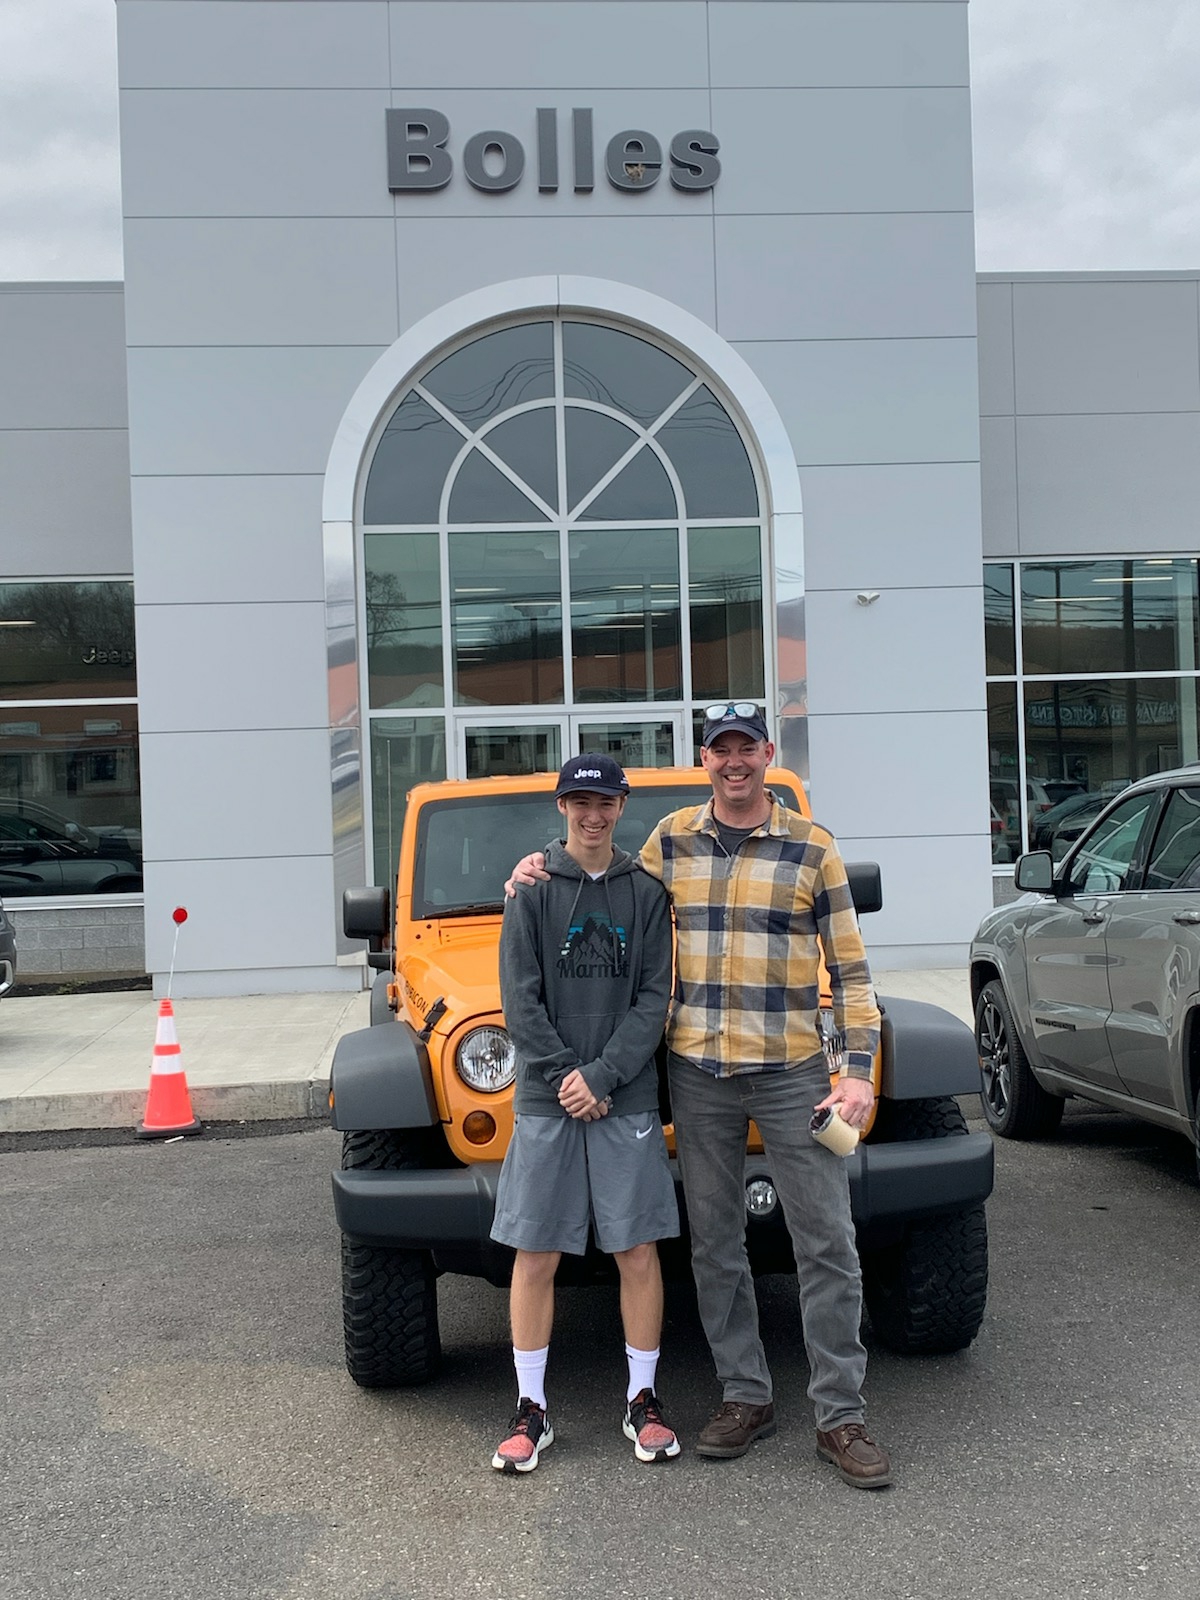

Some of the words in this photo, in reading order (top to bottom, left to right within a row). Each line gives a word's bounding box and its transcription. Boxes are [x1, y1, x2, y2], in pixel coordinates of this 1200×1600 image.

[385, 107, 721, 193] Bolles
[82, 645, 134, 667] Jeep
[574, 768, 602, 779] Jeep
[404, 980, 429, 1014] RUBICON
